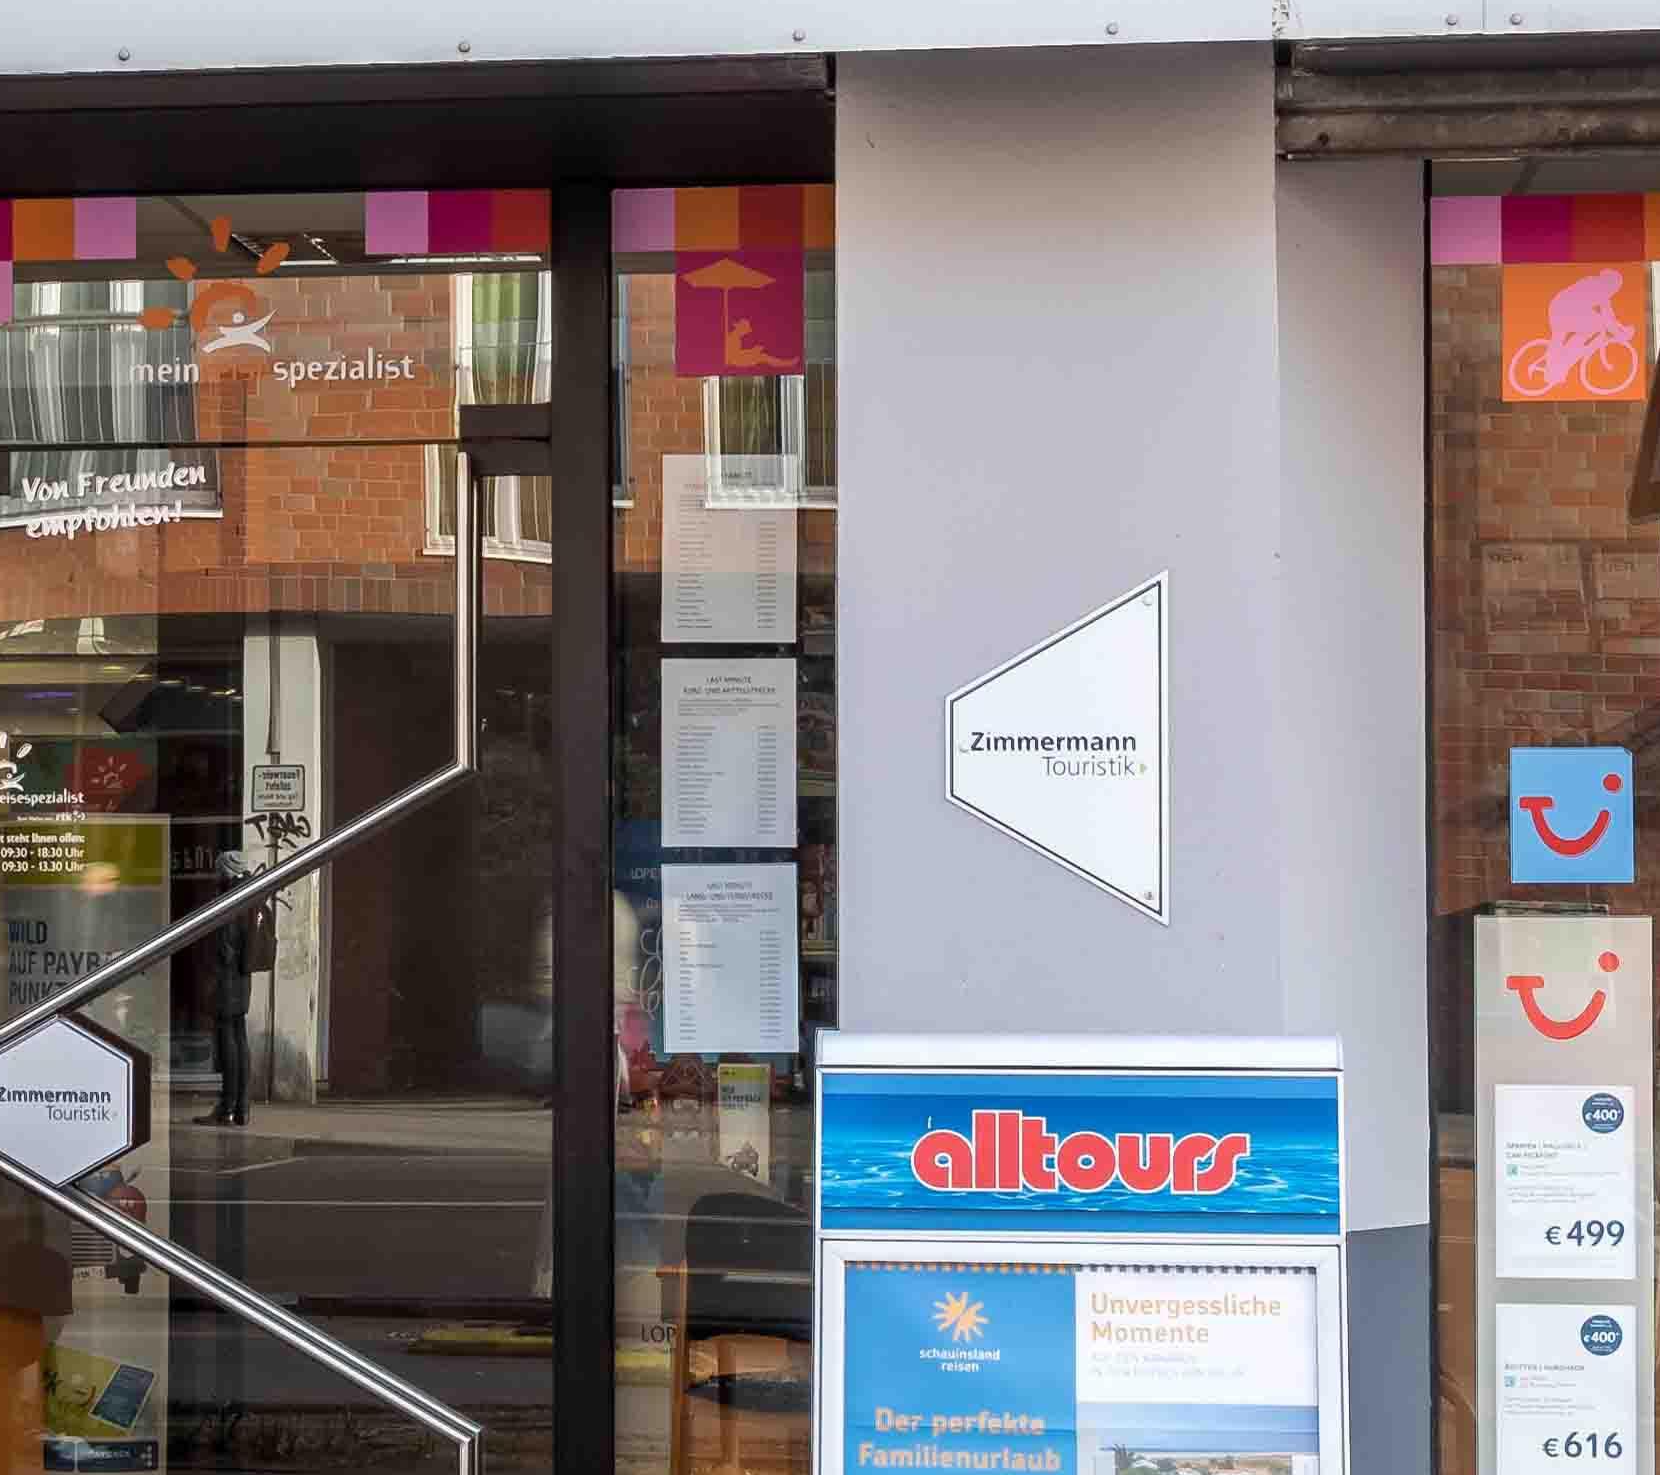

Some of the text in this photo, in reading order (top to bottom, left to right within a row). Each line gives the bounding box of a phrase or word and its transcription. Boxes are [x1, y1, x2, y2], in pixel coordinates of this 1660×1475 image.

[22, 460, 206, 503] Von Freunden
[26, 498, 184, 542] empfohlen!
[970, 730, 1137, 753] Zimmermann
[1041, 754, 1135, 779] Touristik
[6, 833, 30, 844] steht
[31, 832, 58, 844] Ihnen
[64, 846, 85, 858] Uhr
[64, 861, 85, 872] Uhr
[45, 1105, 111, 1124] Touristik
[910, 1109, 1251, 1195] alltours
[1091, 1291, 1281, 1319] Unvergessliche
[1091, 1320, 1209, 1344] Momente
[918, 1346, 1001, 1362] schauinsland
[940, 1360, 980, 1373] reisen
[874, 1407, 1046, 1437] Der perfekte
[858, 1441, 1062, 1472] Familienurlaub
